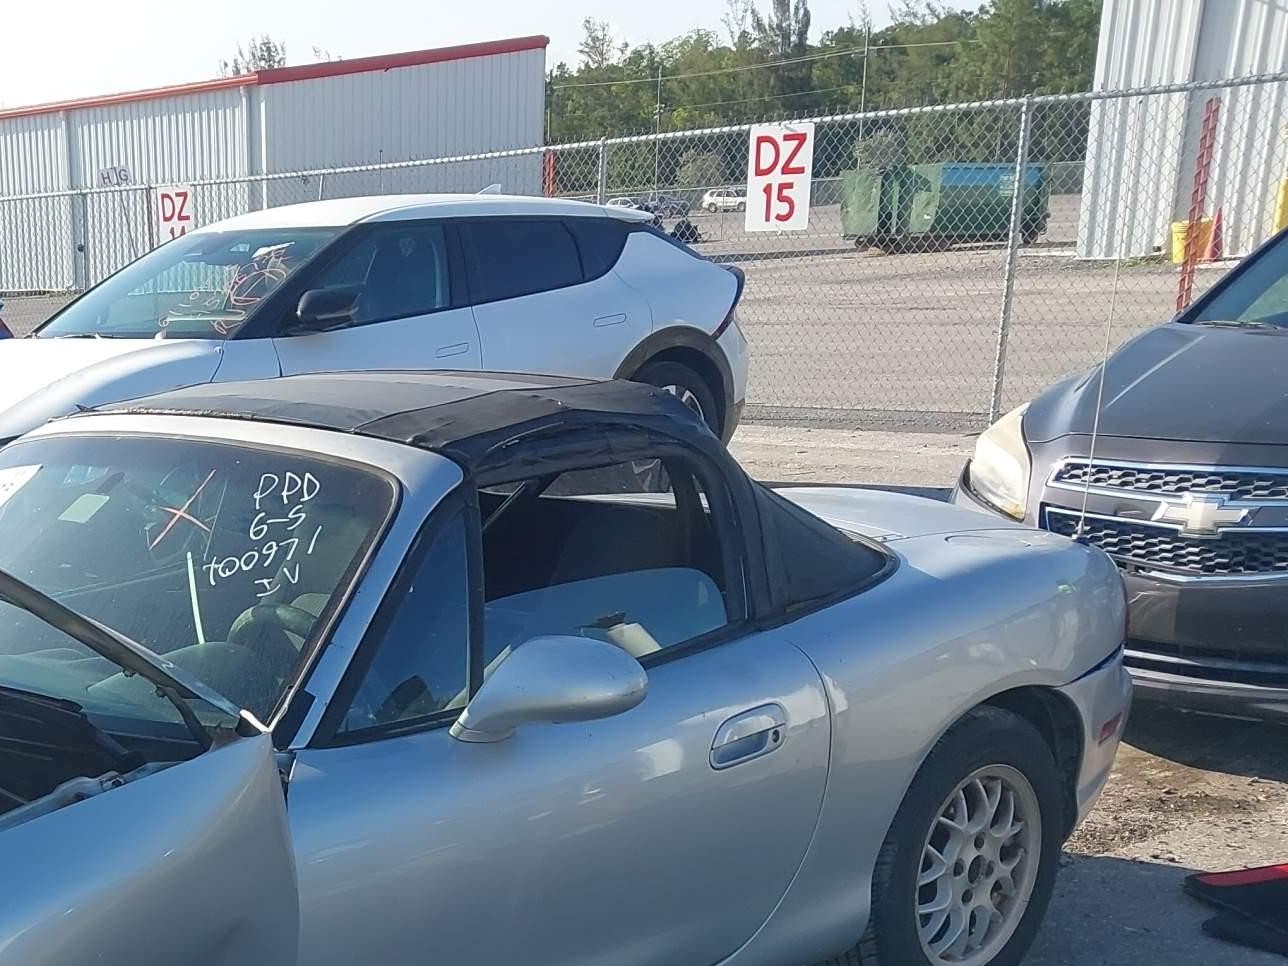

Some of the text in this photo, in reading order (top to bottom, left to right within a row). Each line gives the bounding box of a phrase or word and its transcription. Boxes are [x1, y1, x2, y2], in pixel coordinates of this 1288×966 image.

[755, 133, 807, 176] DZ
[161, 191, 191, 222] DZ
[763, 182, 795, 222] 15
[253, 471, 320, 510] PPD
